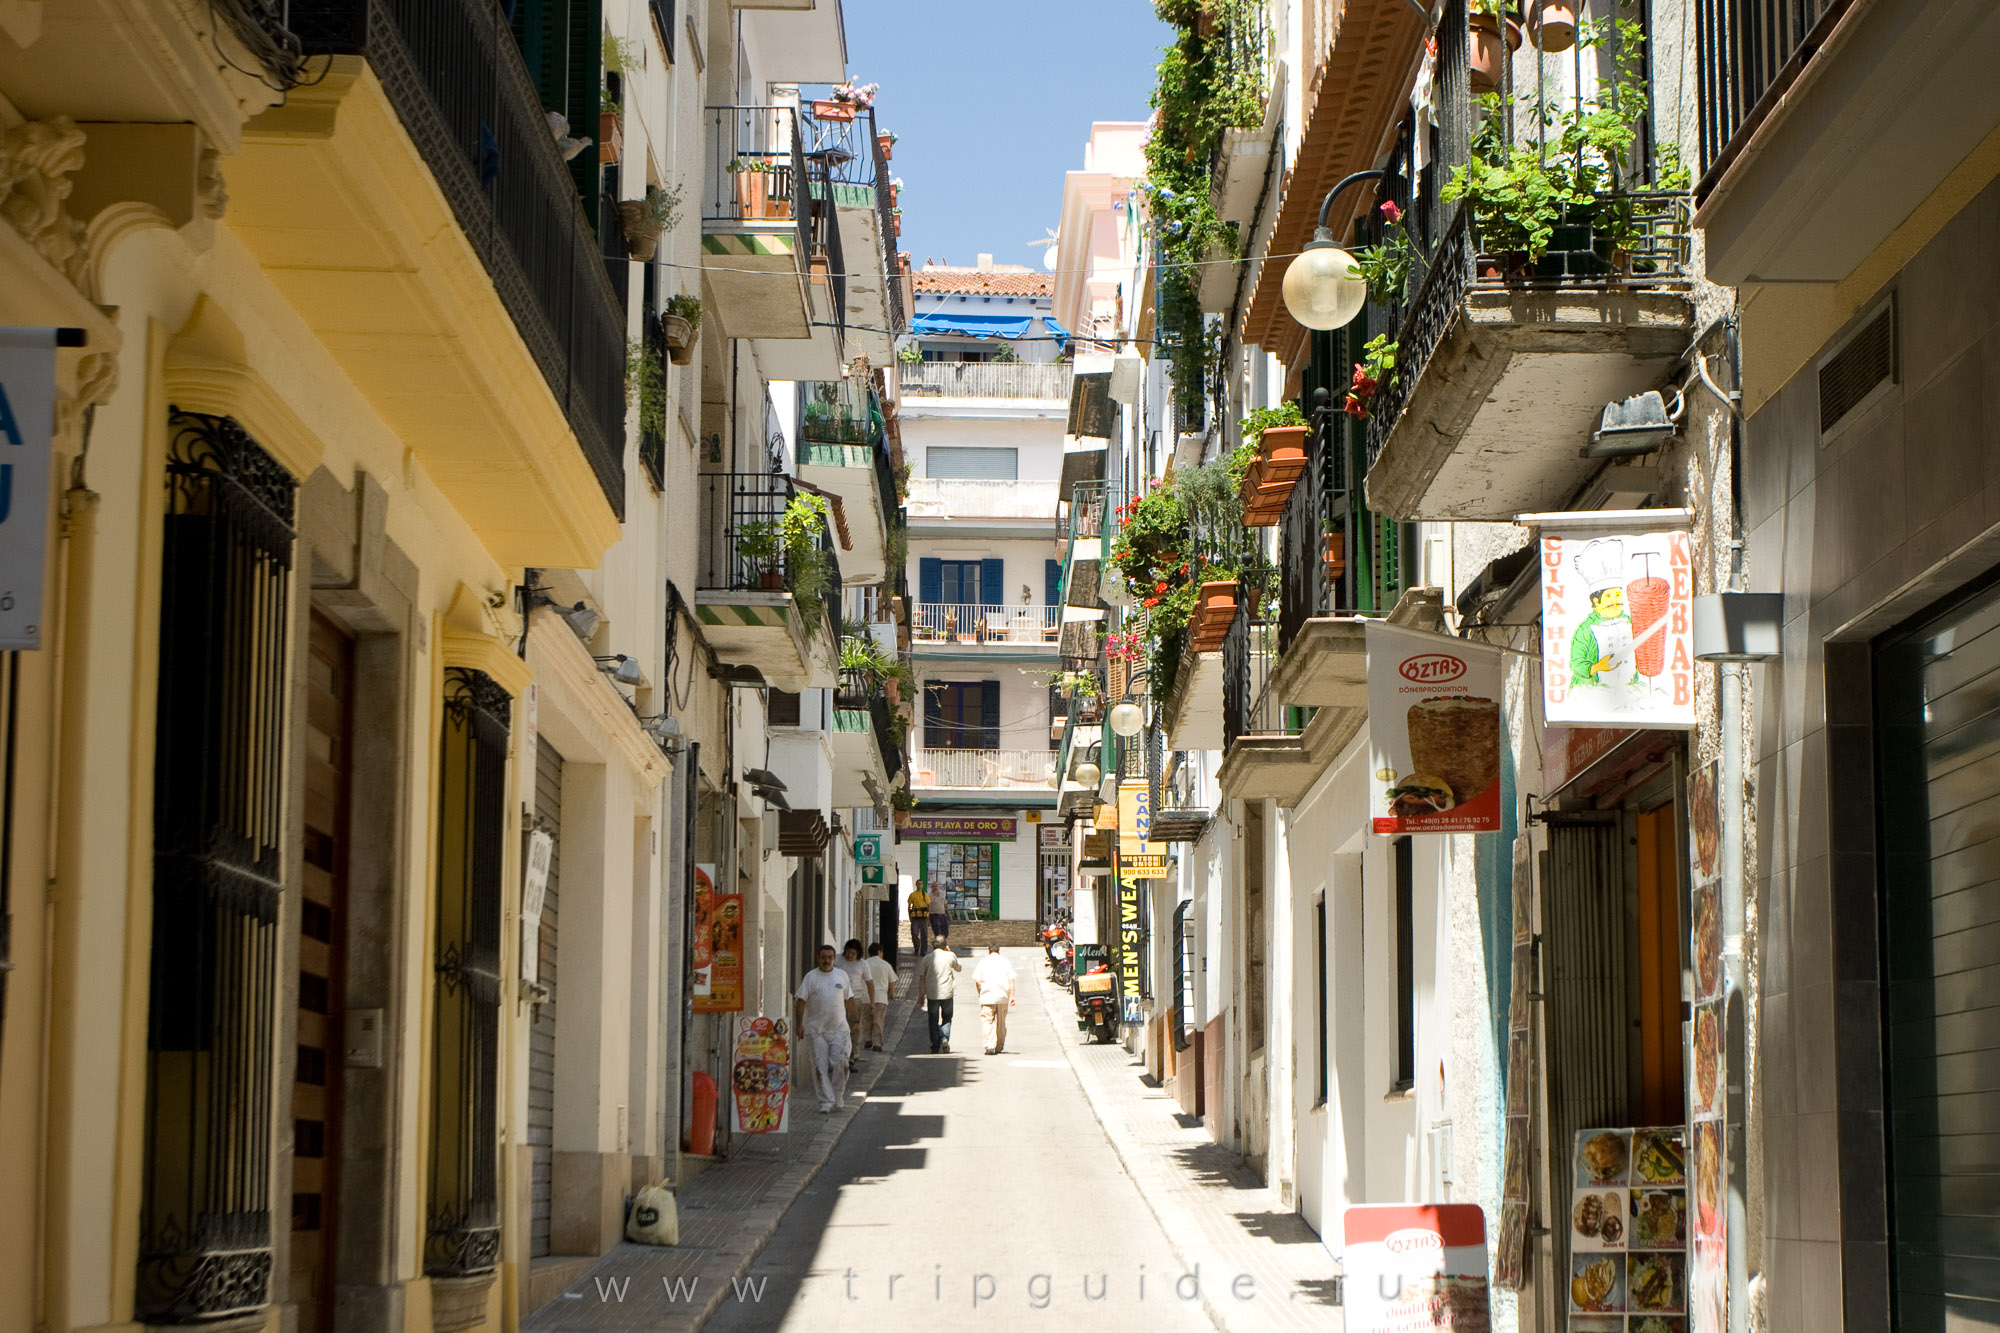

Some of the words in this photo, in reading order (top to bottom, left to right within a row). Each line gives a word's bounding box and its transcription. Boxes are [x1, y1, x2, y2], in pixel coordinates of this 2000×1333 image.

[1544, 535, 1567, 616] CUINA
[1667, 533, 1691, 706] KEBAB
[1398, 685, 1468, 694] DÖNERPRODUKTION
[1546, 626, 1567, 704] HINDU
[905, 821, 932, 829] IAJES
[935, 821, 962, 829] PLAYA
[964, 821, 975, 830] DE
[977, 821, 998, 830] ORO
[1136, 792, 1149, 854] CANVI
